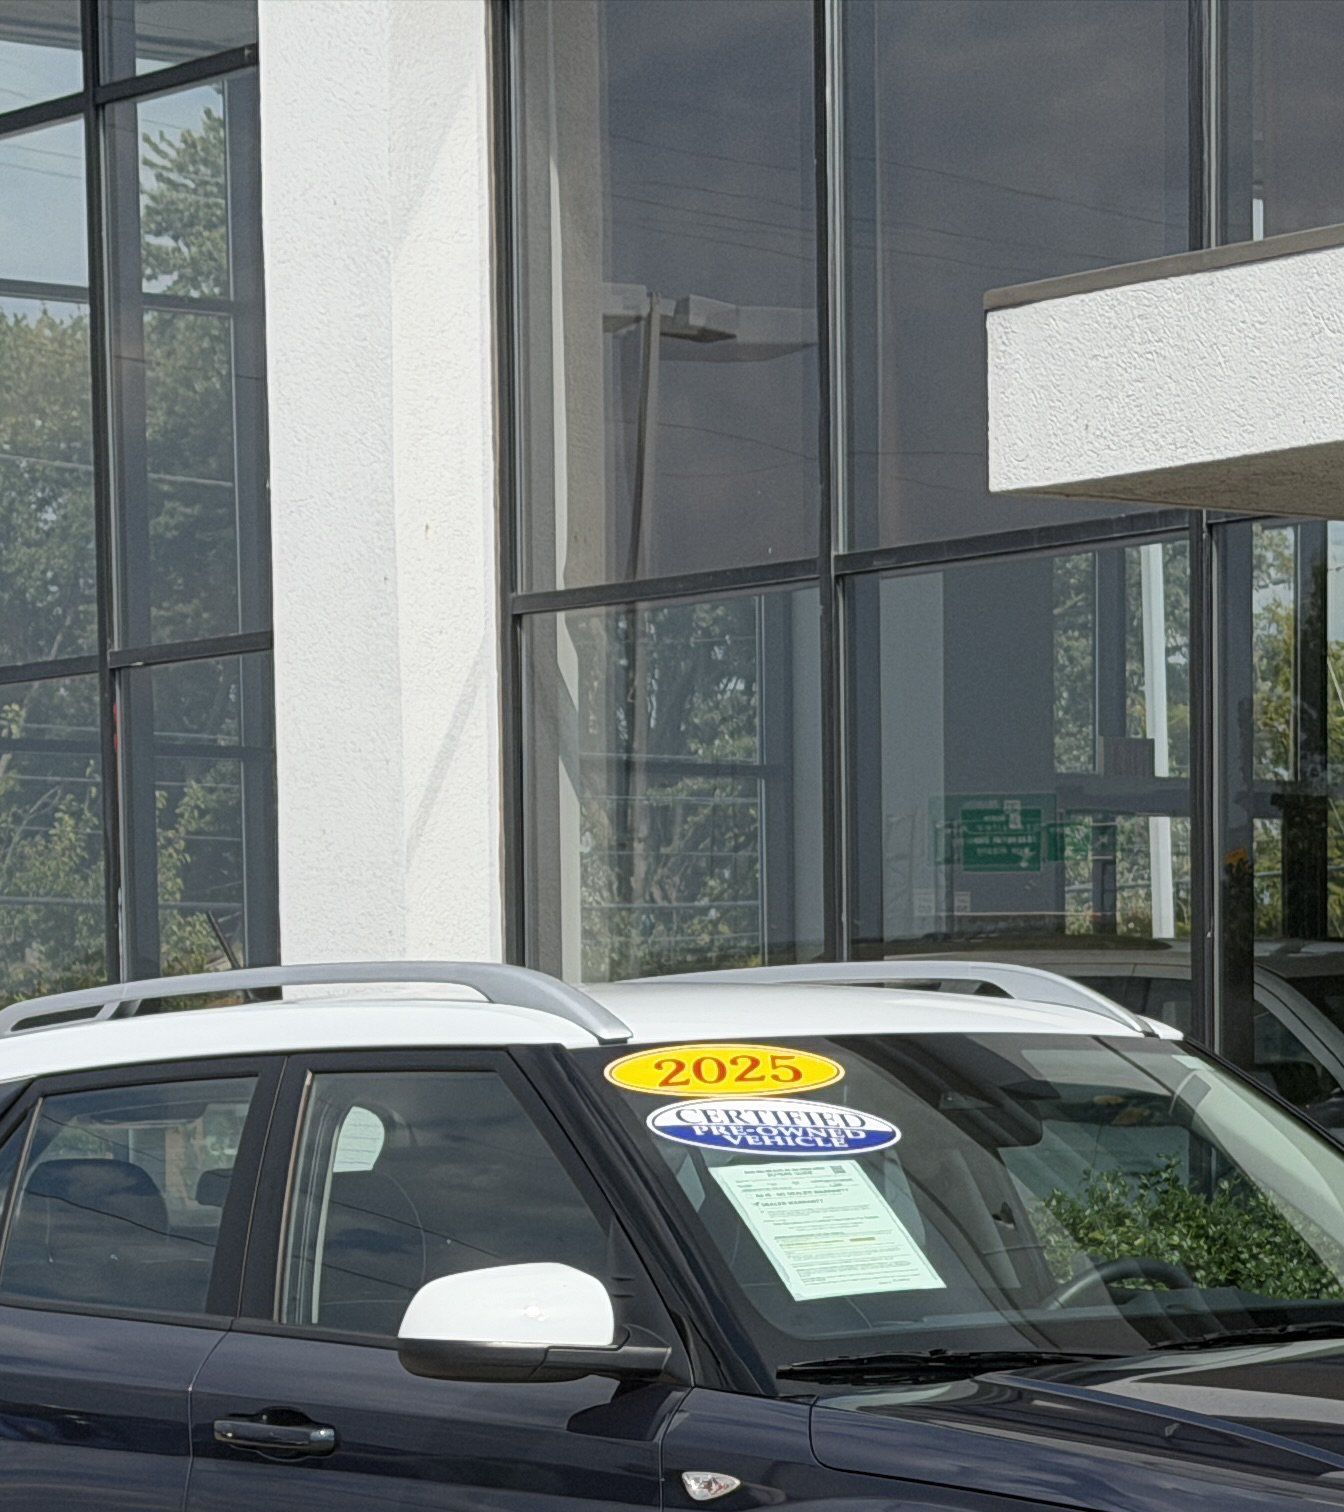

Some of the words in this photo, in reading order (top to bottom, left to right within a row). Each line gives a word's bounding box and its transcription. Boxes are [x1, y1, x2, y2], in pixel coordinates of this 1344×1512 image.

[654, 1055, 803, 1087] 2025
[675, 1108, 866, 1128] CERTIFIED
[691, 1125, 867, 1139] PRE-OWNED
[722, 1135, 849, 1148] VEHICLE
